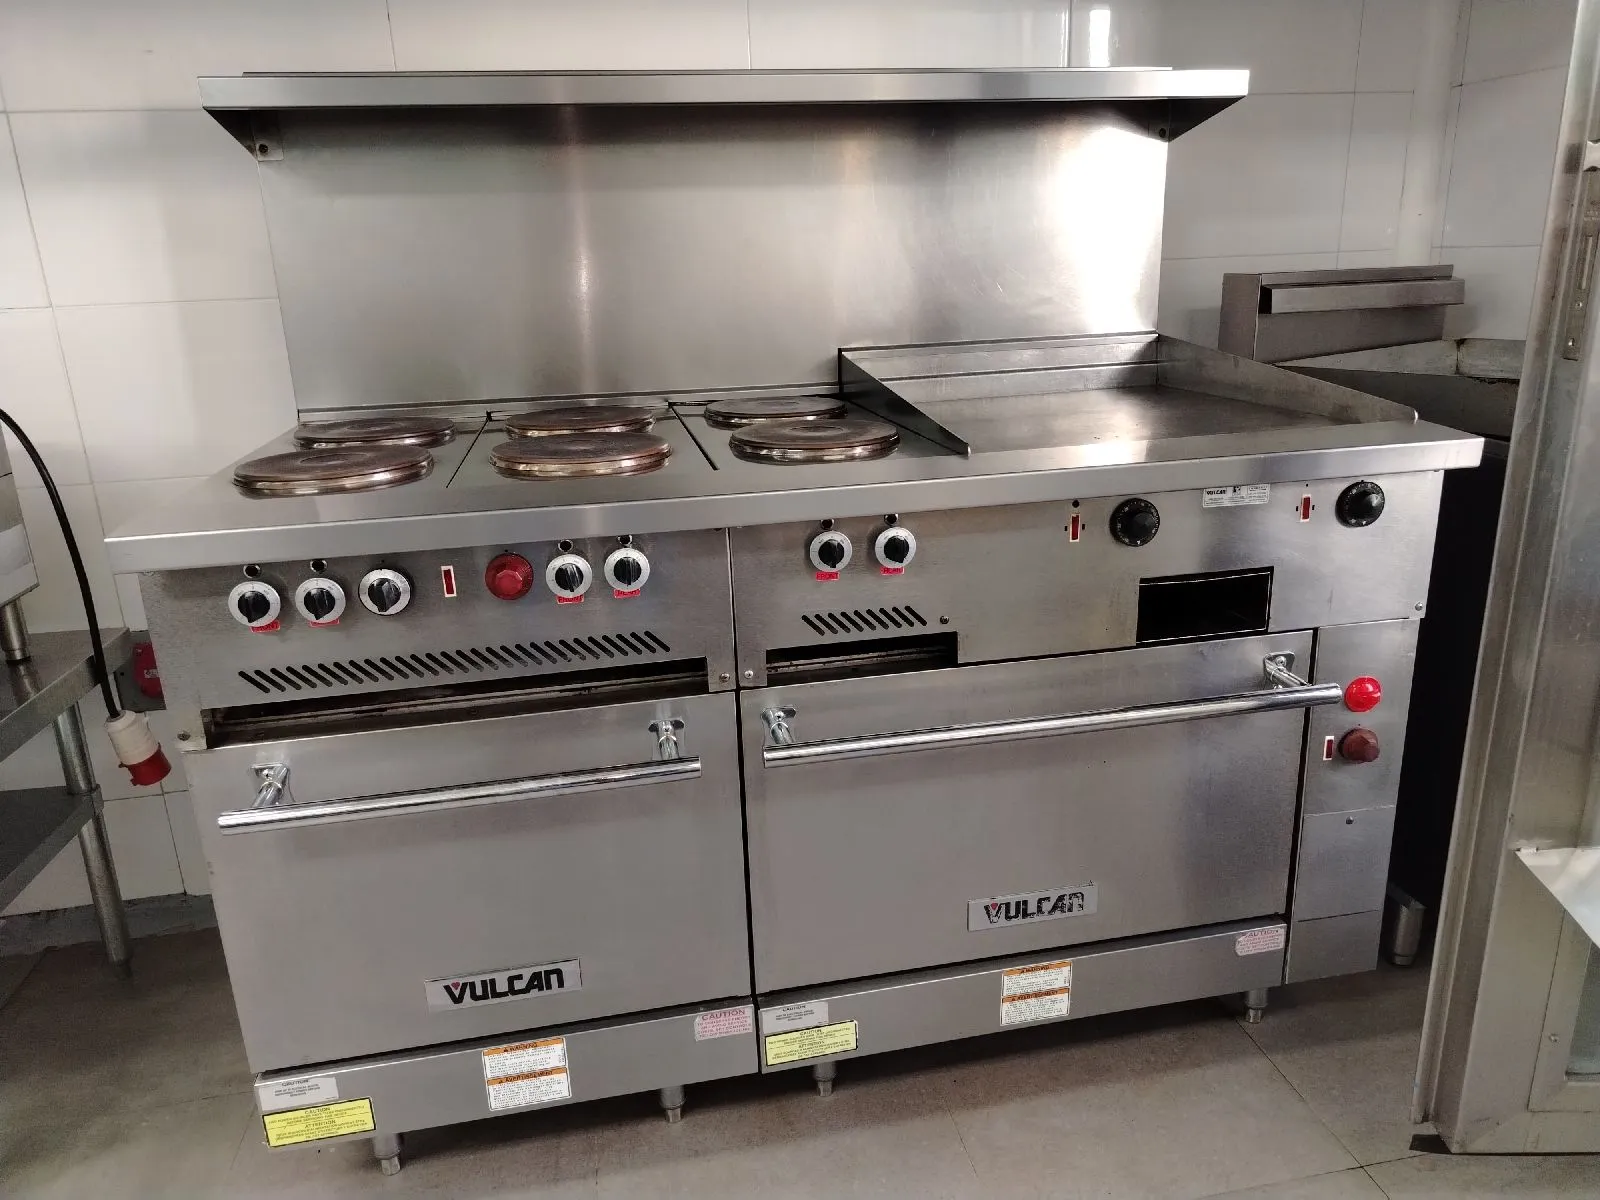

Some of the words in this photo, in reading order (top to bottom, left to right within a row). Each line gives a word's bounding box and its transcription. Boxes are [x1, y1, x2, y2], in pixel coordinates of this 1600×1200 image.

[983, 891, 1085, 924] VULCAN
[443, 968, 565, 1004] VULCAN
[702, 1008, 746, 1021] CAUTION
